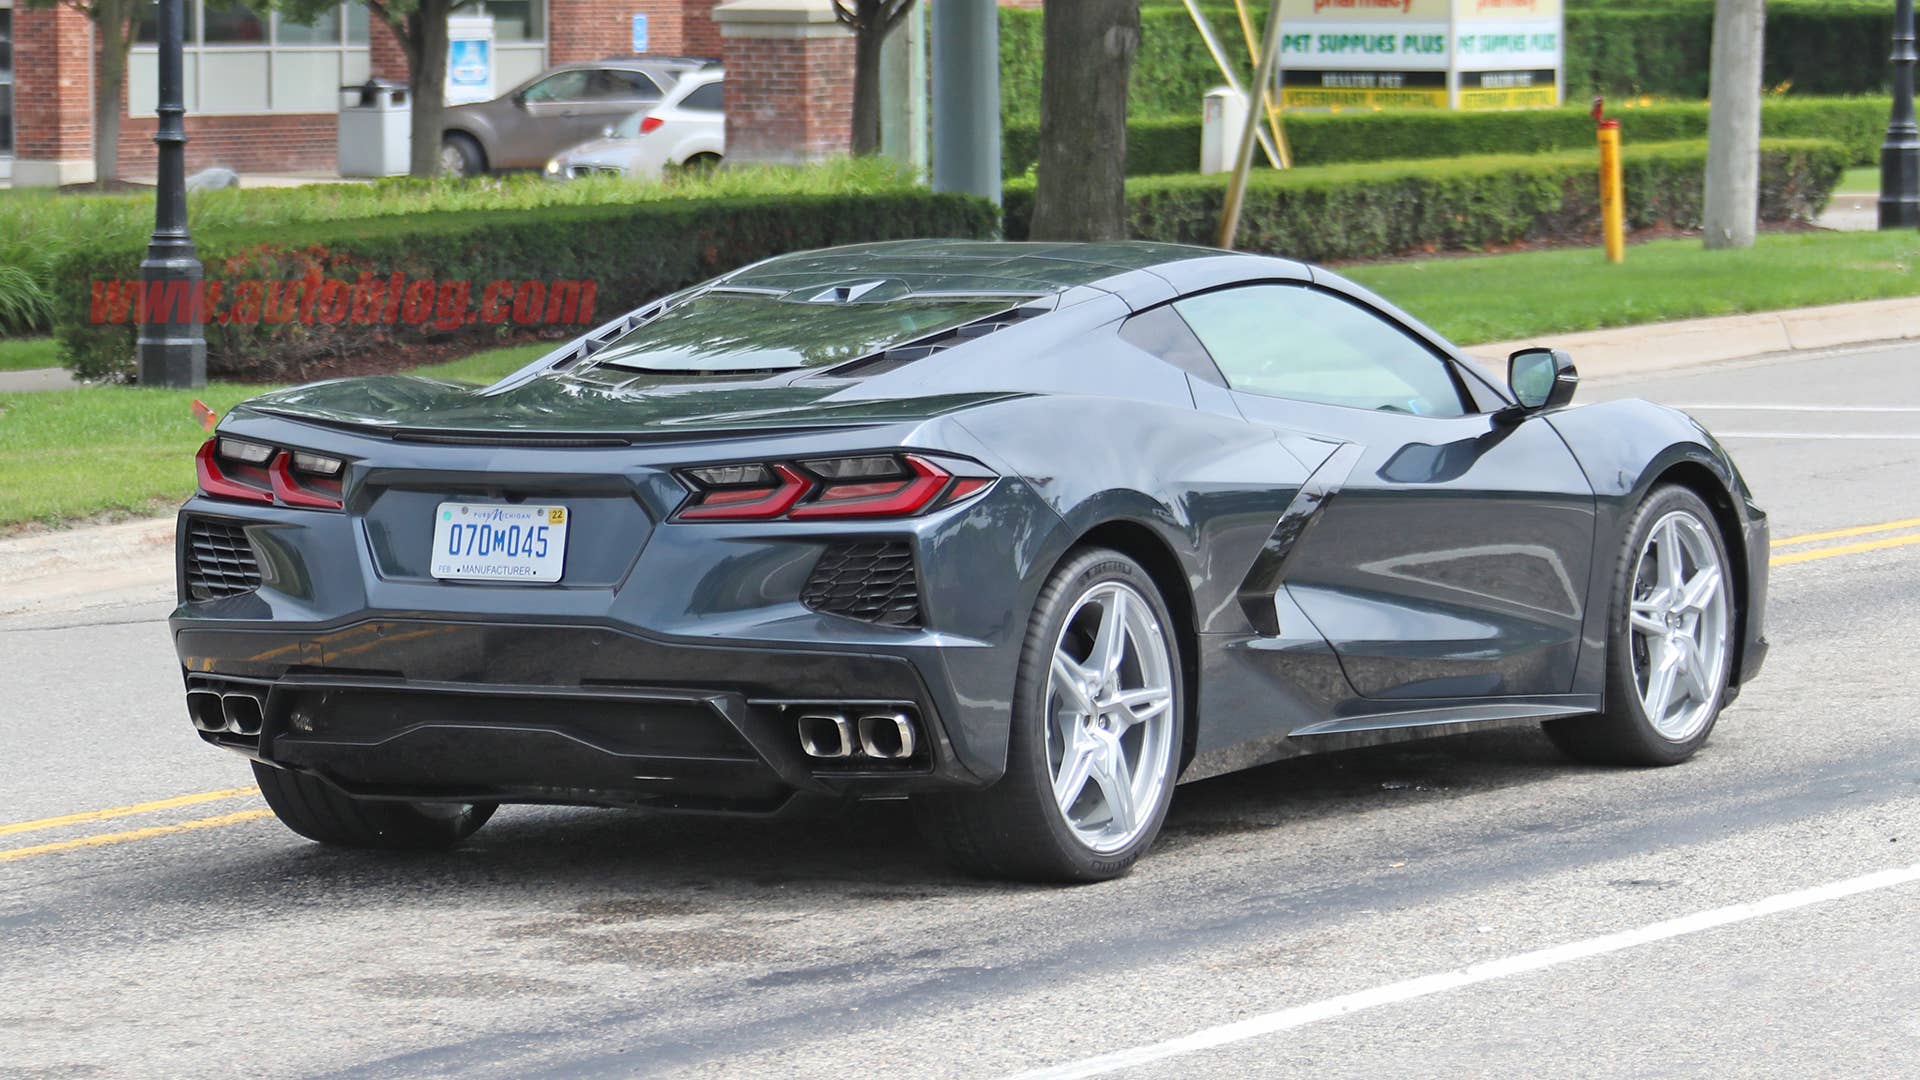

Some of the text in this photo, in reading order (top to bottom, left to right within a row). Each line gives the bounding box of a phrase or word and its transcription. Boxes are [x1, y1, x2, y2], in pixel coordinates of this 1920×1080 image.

[1281, 34, 1445, 53] PET SUPPLIES PLUS
[551, 510, 563, 519] 22
[448, 523, 549, 558] 070M045
[462, 565, 531, 576] MANUFACTURER
